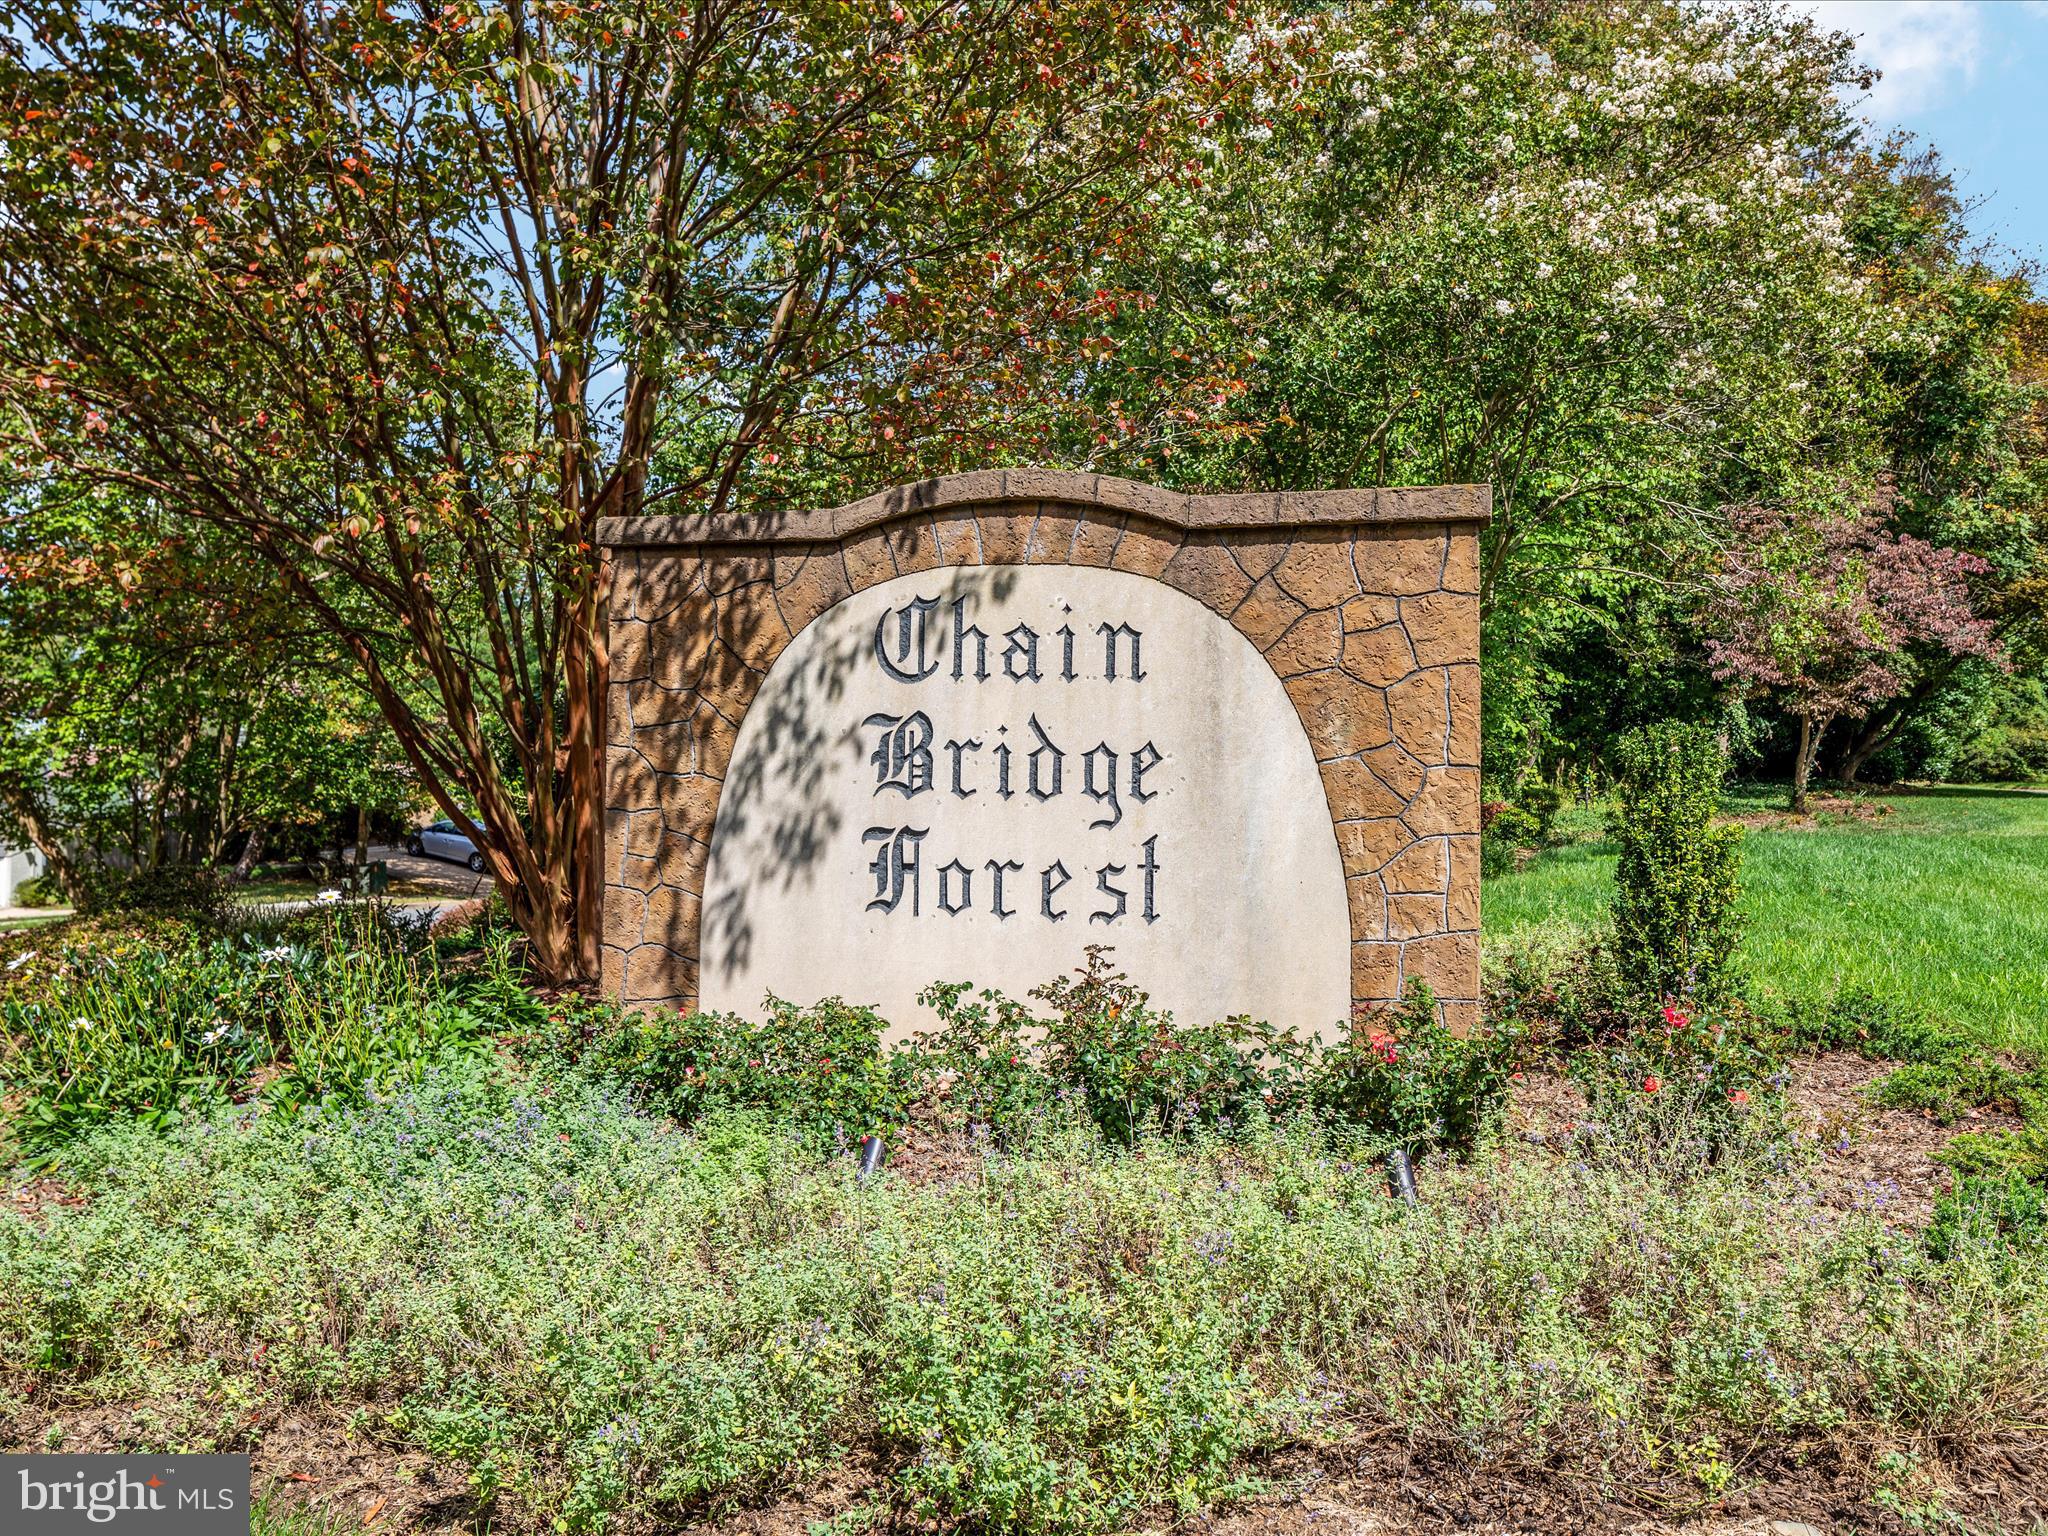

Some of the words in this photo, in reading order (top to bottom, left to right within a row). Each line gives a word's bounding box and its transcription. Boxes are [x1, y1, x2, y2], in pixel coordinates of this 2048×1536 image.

[874, 594, 1147, 684] Chain
[861, 710, 1163, 831] Bridge
[861, 825, 1160, 925] Forest
